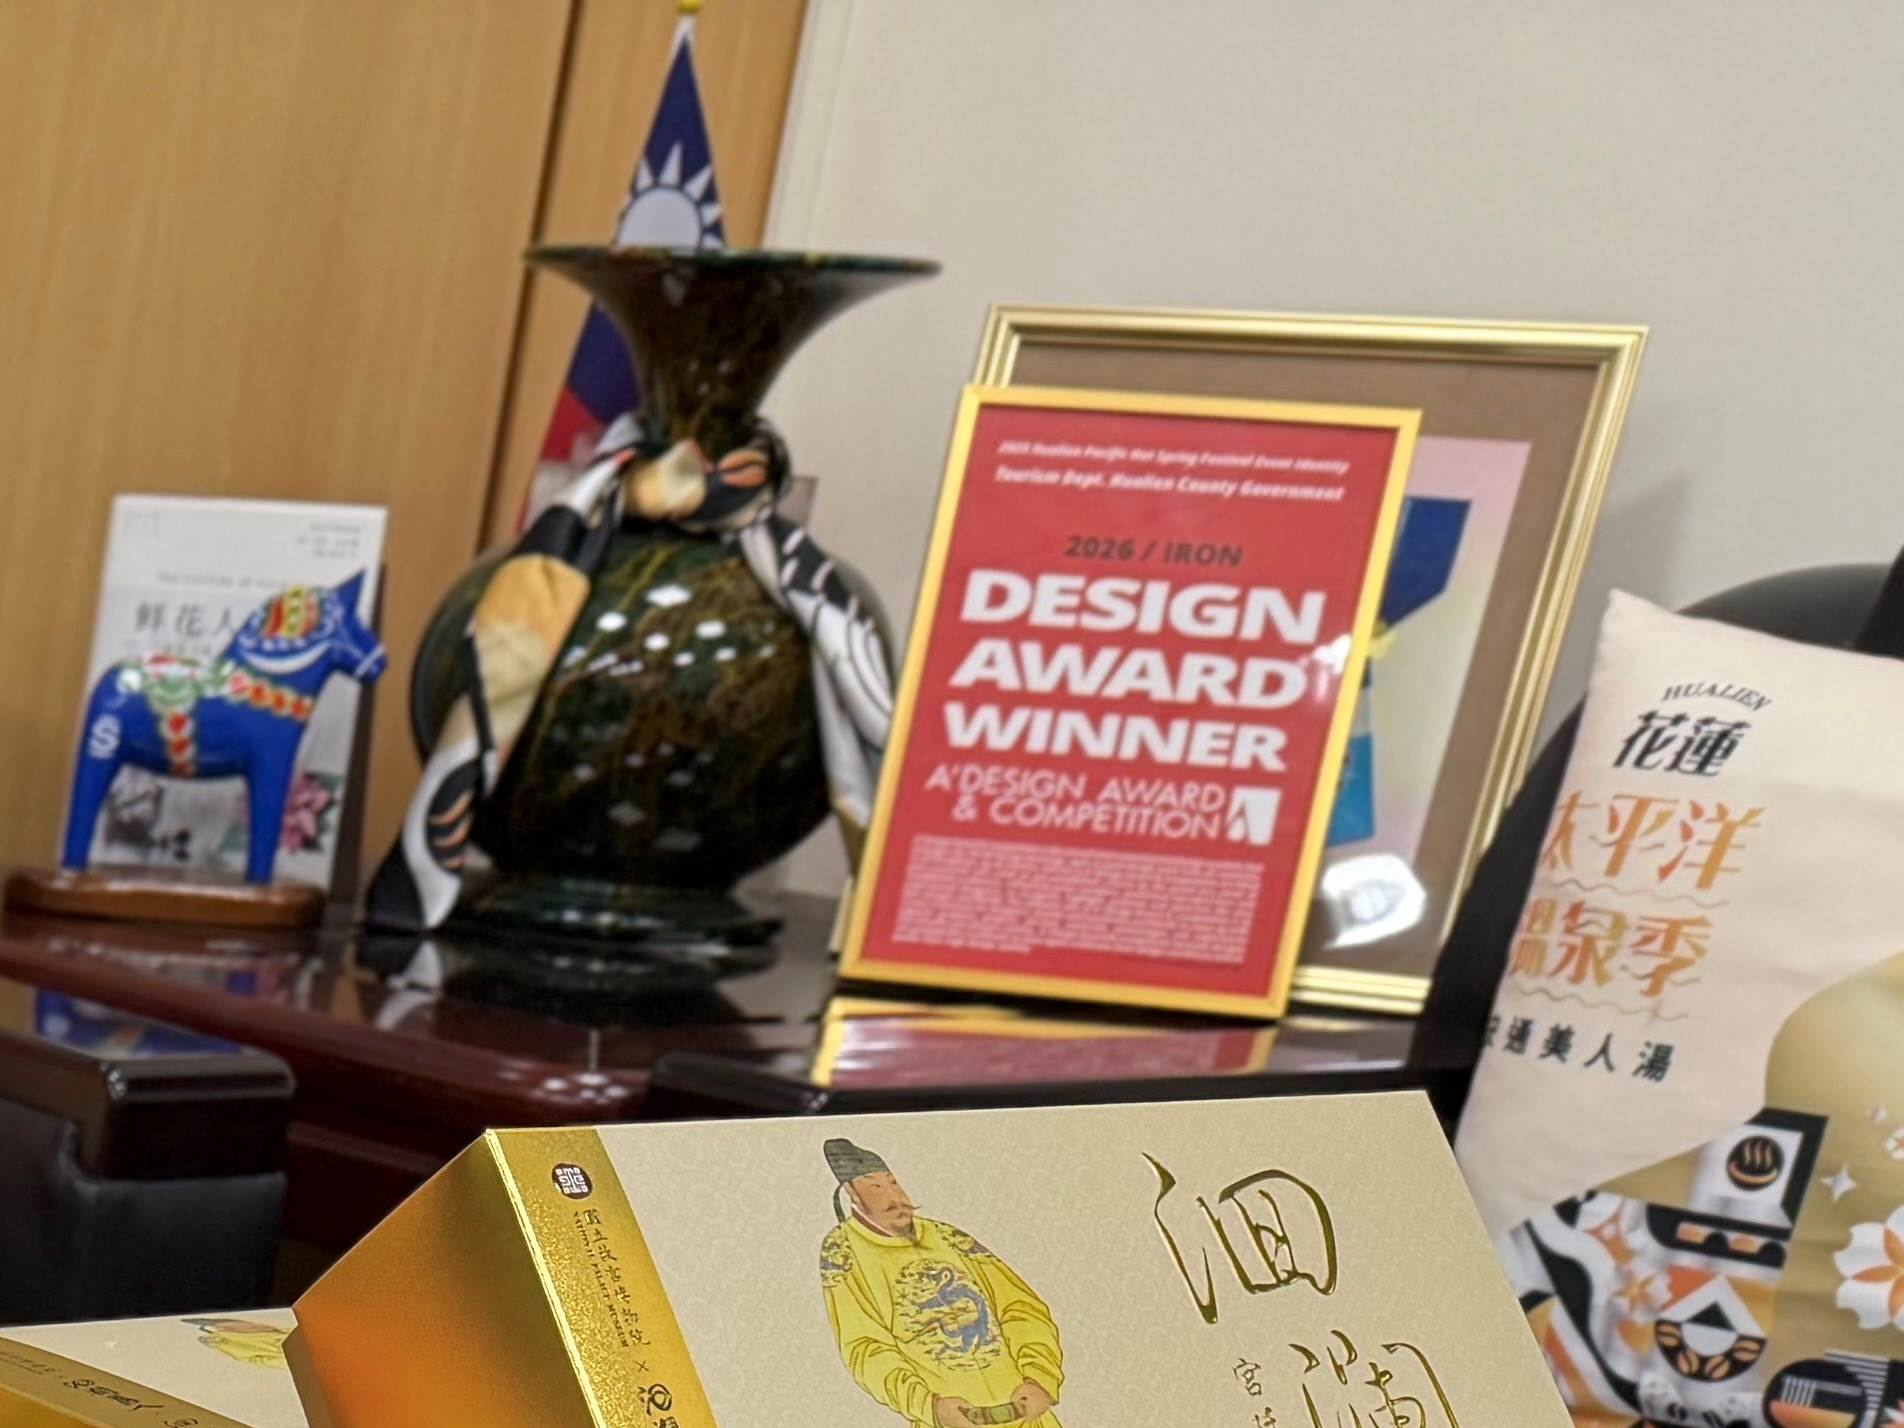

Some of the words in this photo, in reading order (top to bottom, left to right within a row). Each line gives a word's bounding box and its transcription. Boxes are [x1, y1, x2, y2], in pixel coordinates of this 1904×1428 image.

[995, 466, 1059, 486] Tourism
[1062, 470, 1104, 489] Dept.
[1110, 473, 1173, 492] Hualien
[1178, 477, 1235, 498] County
[1240, 480, 1345, 501] Government
[1065, 536, 1134, 561] 2026
[1165, 543, 1243, 567] IRON
[961, 569, 1326, 644] DESIGN
[949, 638, 1308, 711] AWARD
[1662, 680, 1772, 713] HUALIEN
[943, 703, 1288, 772] WINNER
[1611, 708, 1753, 779] 花蓮
[990, 797, 1226, 842] COMPETITION
[1103, 774, 1226, 812] AWARD
[1540, 790, 1768, 894] 太平洋
